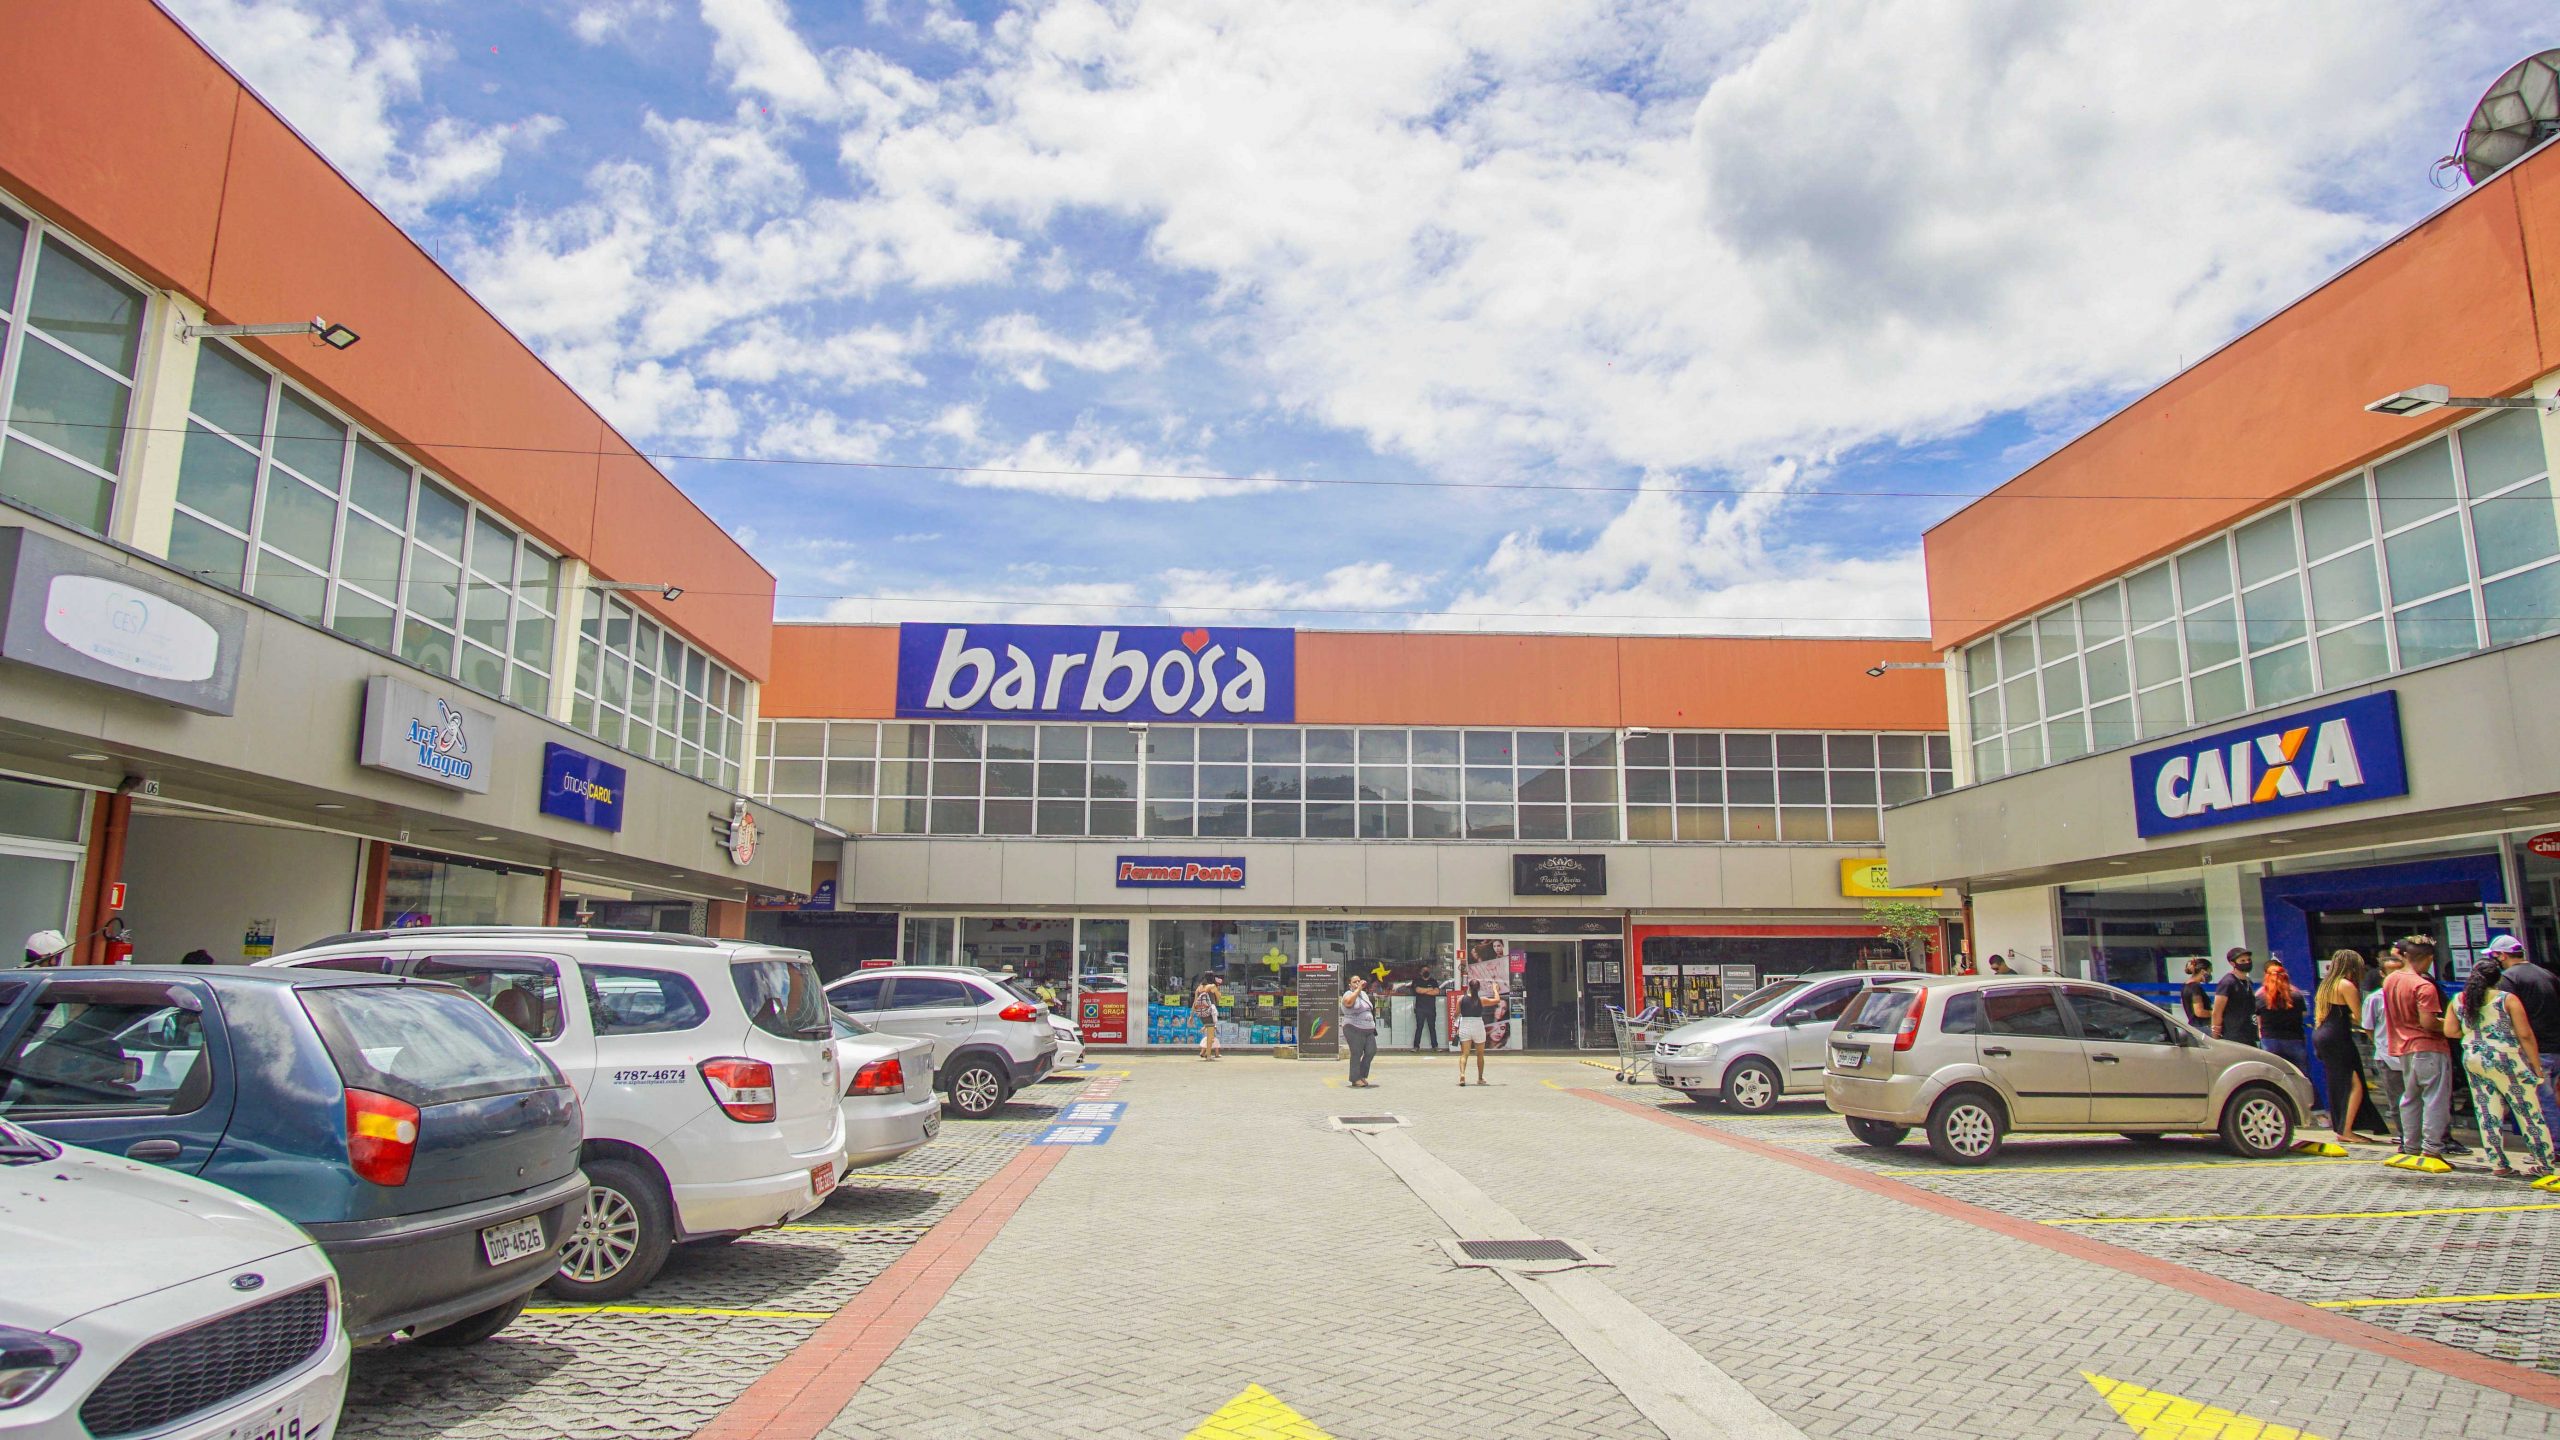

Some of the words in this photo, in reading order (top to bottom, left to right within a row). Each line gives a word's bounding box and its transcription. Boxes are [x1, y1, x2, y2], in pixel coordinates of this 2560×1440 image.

[925, 628, 1267, 718] barbosa
[406, 718, 439, 747] Art
[417, 743, 472, 779] Magno
[2155, 718, 2366, 820] CAIXA
[147, 781, 158, 794] 06
[1119, 862, 1183, 881] Farma
[1184, 863, 1243, 882] Ponte
[614, 1069, 686, 1080] 4787-4674
